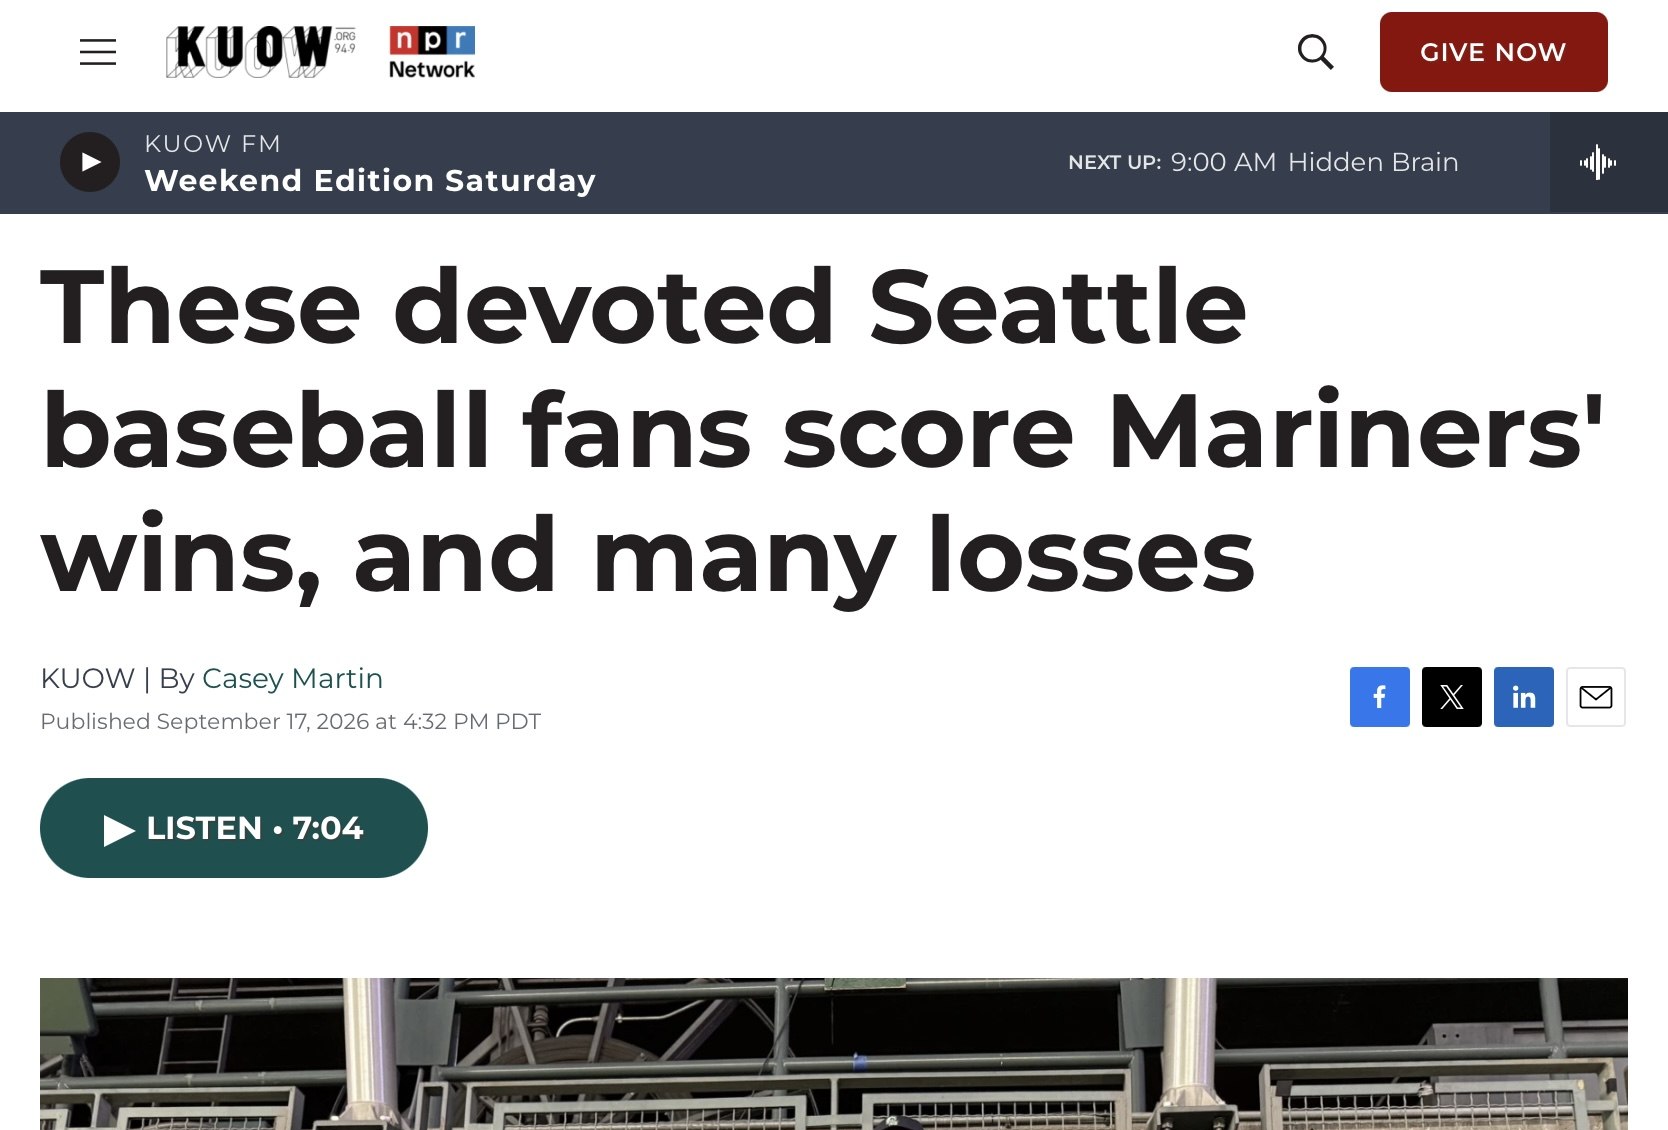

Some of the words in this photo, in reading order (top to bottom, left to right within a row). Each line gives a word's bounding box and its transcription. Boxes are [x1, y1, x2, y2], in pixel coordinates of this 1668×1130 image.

[166, 26, 332, 78] KUOW
[398, 31, 467, 51] npr
[1420, 42, 1485, 62] GIVE
[1496, 42, 1567, 62] NOW
[389, 60, 476, 79] Network
[146, 134, 231, 153] KUOW
[243, 134, 279, 153] FM
[1069, 154, 1122, 170] NEXT
[1128, 154, 1162, 170] UP:
[1171, 151, 1226, 172] 9:00
[1233, 152, 1276, 172] AM
[1289, 151, 1383, 172] Hidden
[1393, 151, 1458, 172] Brain
[144, 168, 301, 192] Weekend
[315, 166, 433, 192] Edition
[445, 167, 597, 198] Saturday
[39, 265, 360, 345] These
[394, 265, 832, 345] devoted
[870, 265, 1246, 345] Seattle
[46, 389, 487, 469] baseball
[522, 388, 751, 469] fans
[783, 409, 1073, 469] score
[1112, 384, 1602, 469] Mariners'
[39, 508, 320, 608] wins,
[355, 513, 554, 593] and
[596, 533, 898, 613] many
[931, 513, 1255, 593] losses
[42, 667, 135, 689] KUOW
[160, 667, 196, 695] By
[202, 667, 285, 695] Casey
[293, 666, 383, 689] Martin
[41, 711, 150, 730] Published
[157, 711, 281, 734] September
[285, 712, 311, 733] 17,
[316, 712, 370, 730] 2026
[375, 714, 397, 730] at
[403, 712, 447, 730] 4:32
[454, 712, 488, 730] PM
[496, 712, 542, 730] PDT
[147, 815, 262, 841] LISTEN
[292, 815, 365, 841] 7:04
